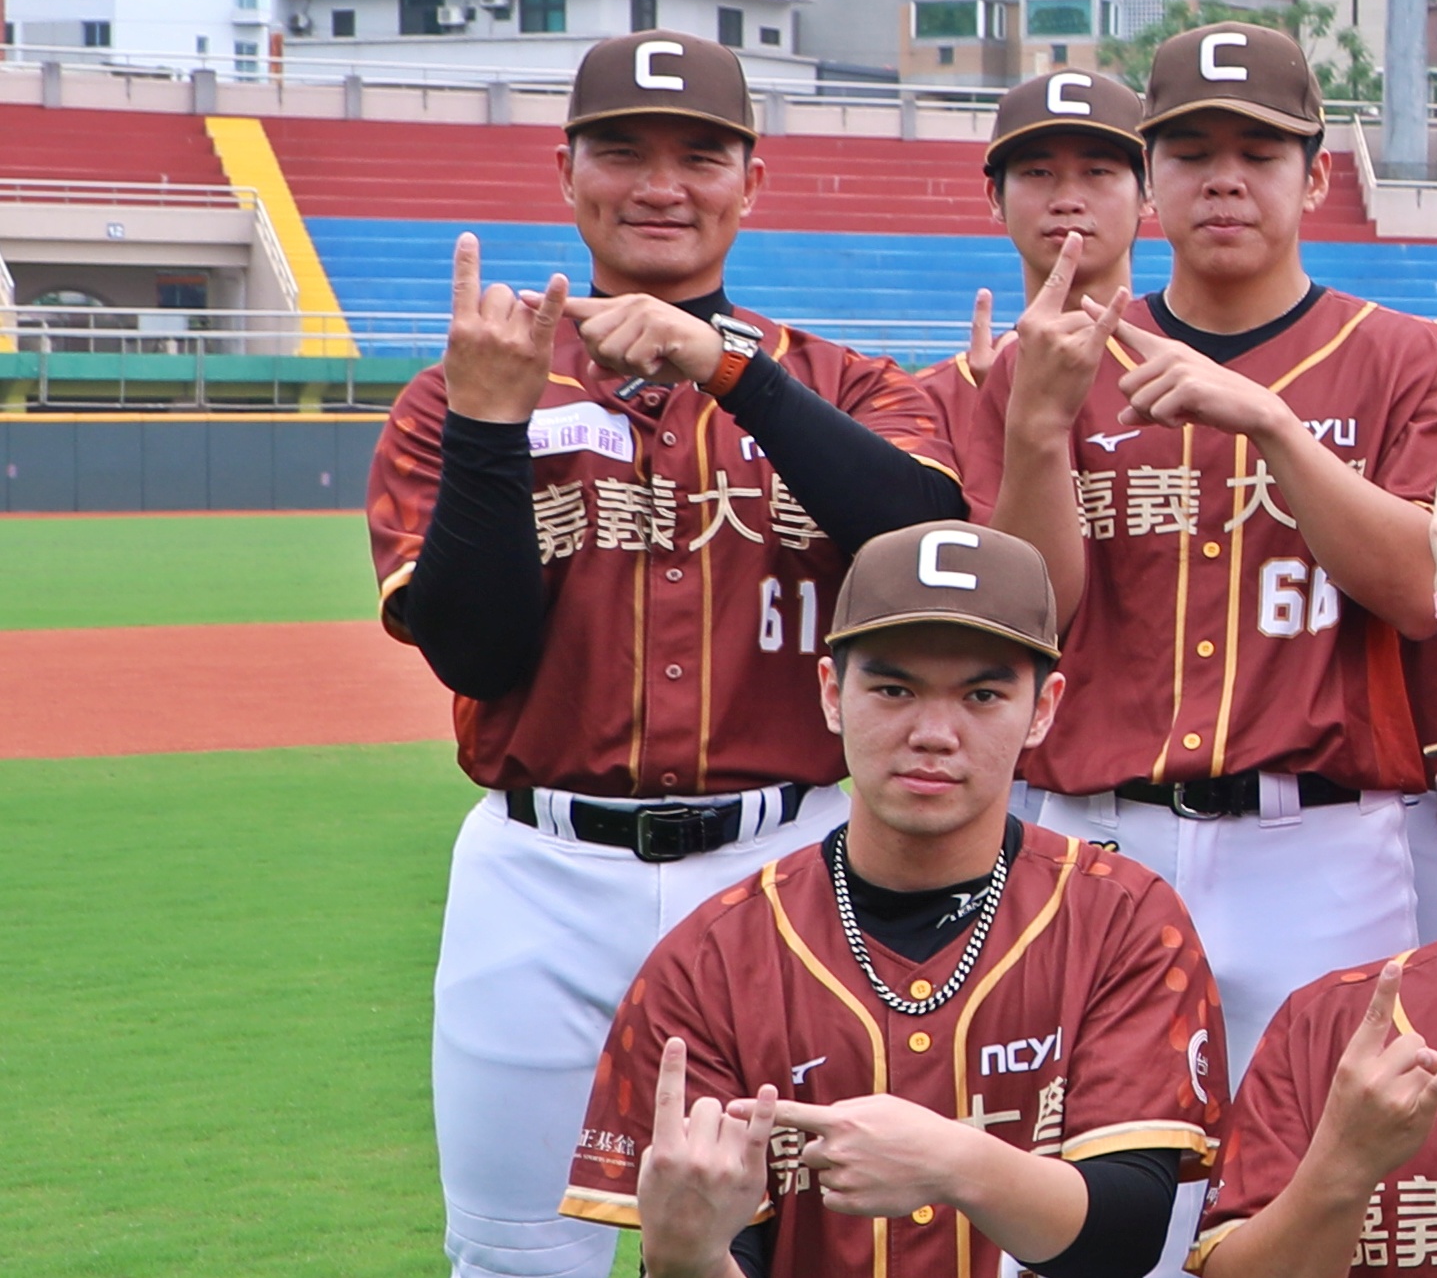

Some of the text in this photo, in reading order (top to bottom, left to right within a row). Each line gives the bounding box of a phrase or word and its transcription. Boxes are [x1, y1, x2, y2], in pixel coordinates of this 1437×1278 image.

[635, 41, 685, 90] C
[1200, 33, 1248, 80] C
[1047, 73, 1093, 116] C
[1074, 459, 1366, 543] 嘉義大
[917, 530, 979, 590] C
[758, 578, 818, 655] 61
